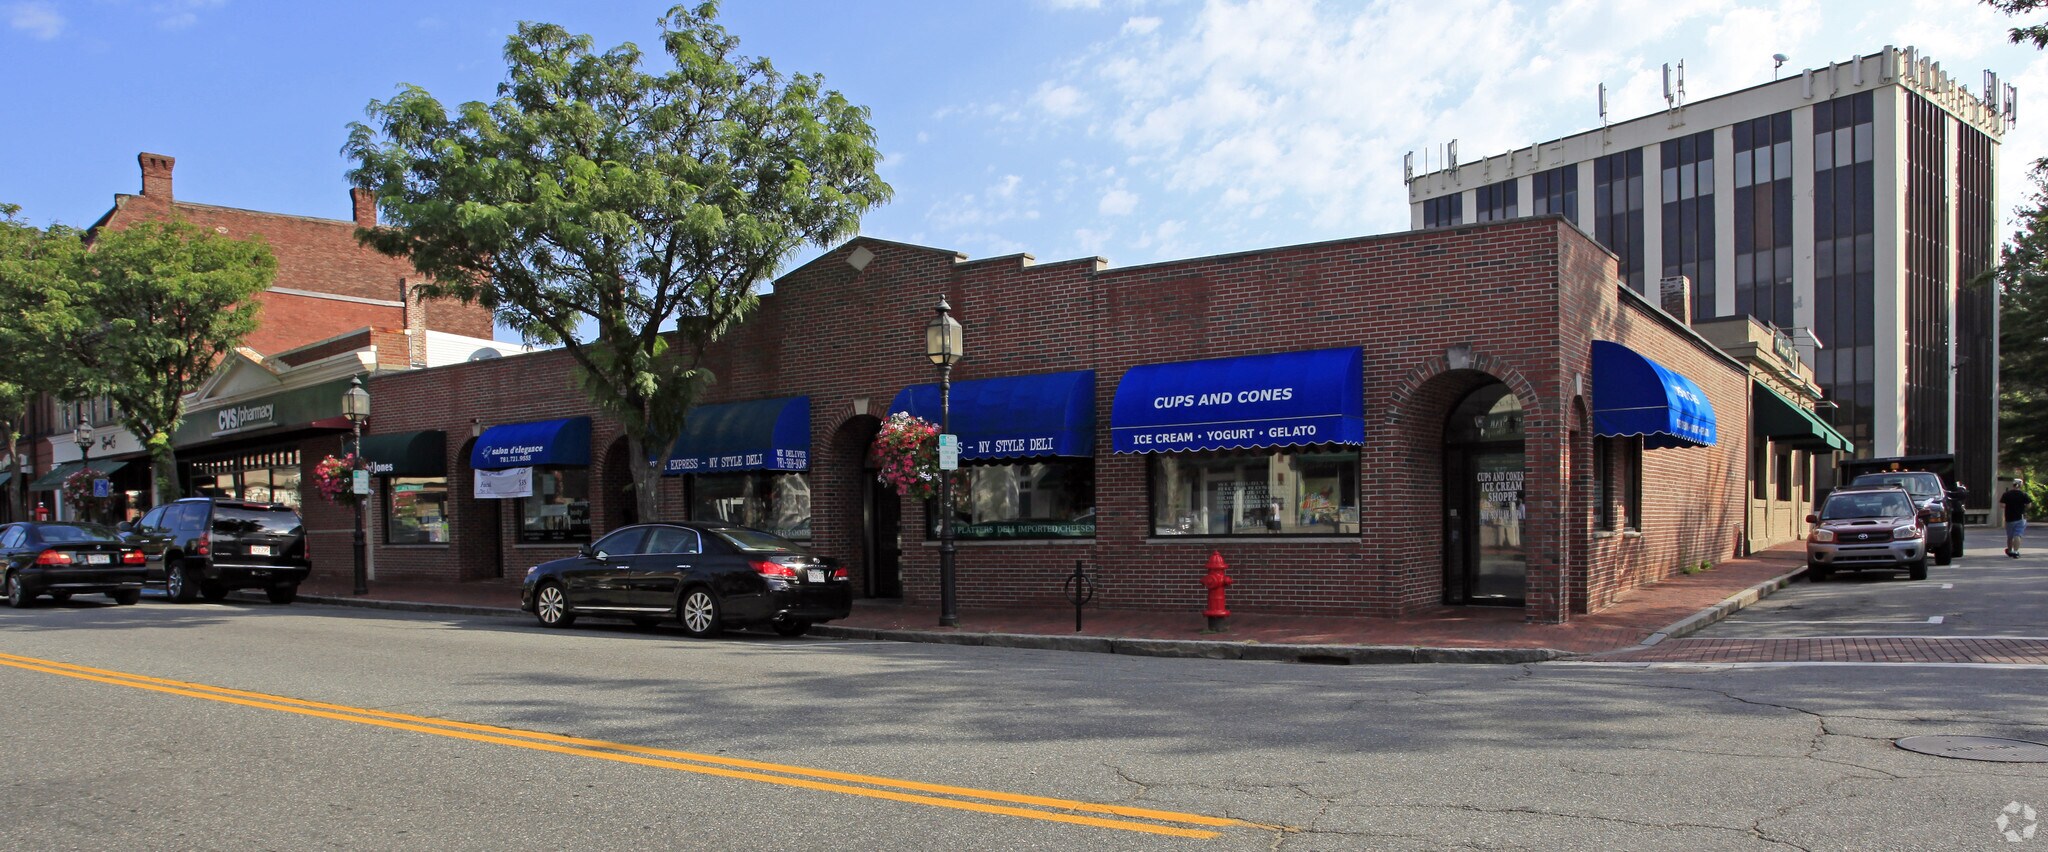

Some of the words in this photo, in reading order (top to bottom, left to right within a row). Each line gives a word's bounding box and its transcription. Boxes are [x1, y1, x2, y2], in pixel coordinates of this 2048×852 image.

[1153, 394, 1195, 409] CUPS
[1198, 392, 1233, 406] AND
[1237, 387, 1293, 404] CONES
[1133, 434, 1153, 445] ICE
[1155, 432, 1194, 443] CREAM
[1206, 428, 1255, 441] YOGURT
[1268, 425, 1317, 438] GELATO
[978, 440, 991, 453] NY
[995, 438, 1025, 453] STYLE
[1030, 437, 1054, 451] DELI
[670, 458, 699, 470] EXPRESS
[709, 457, 718, 468] NY
[721, 455, 743, 468] STYLE
[745, 453, 763, 465] DELI
[1477, 472, 1492, 482] CUPS
[1492, 472, 1505, 481] AND
[1505, 471, 1525, 481] CONES
[1481, 482, 1495, 492] ICE
[1496, 481, 1523, 491] CREAM
[1488, 491, 1518, 502] SHOPPE
